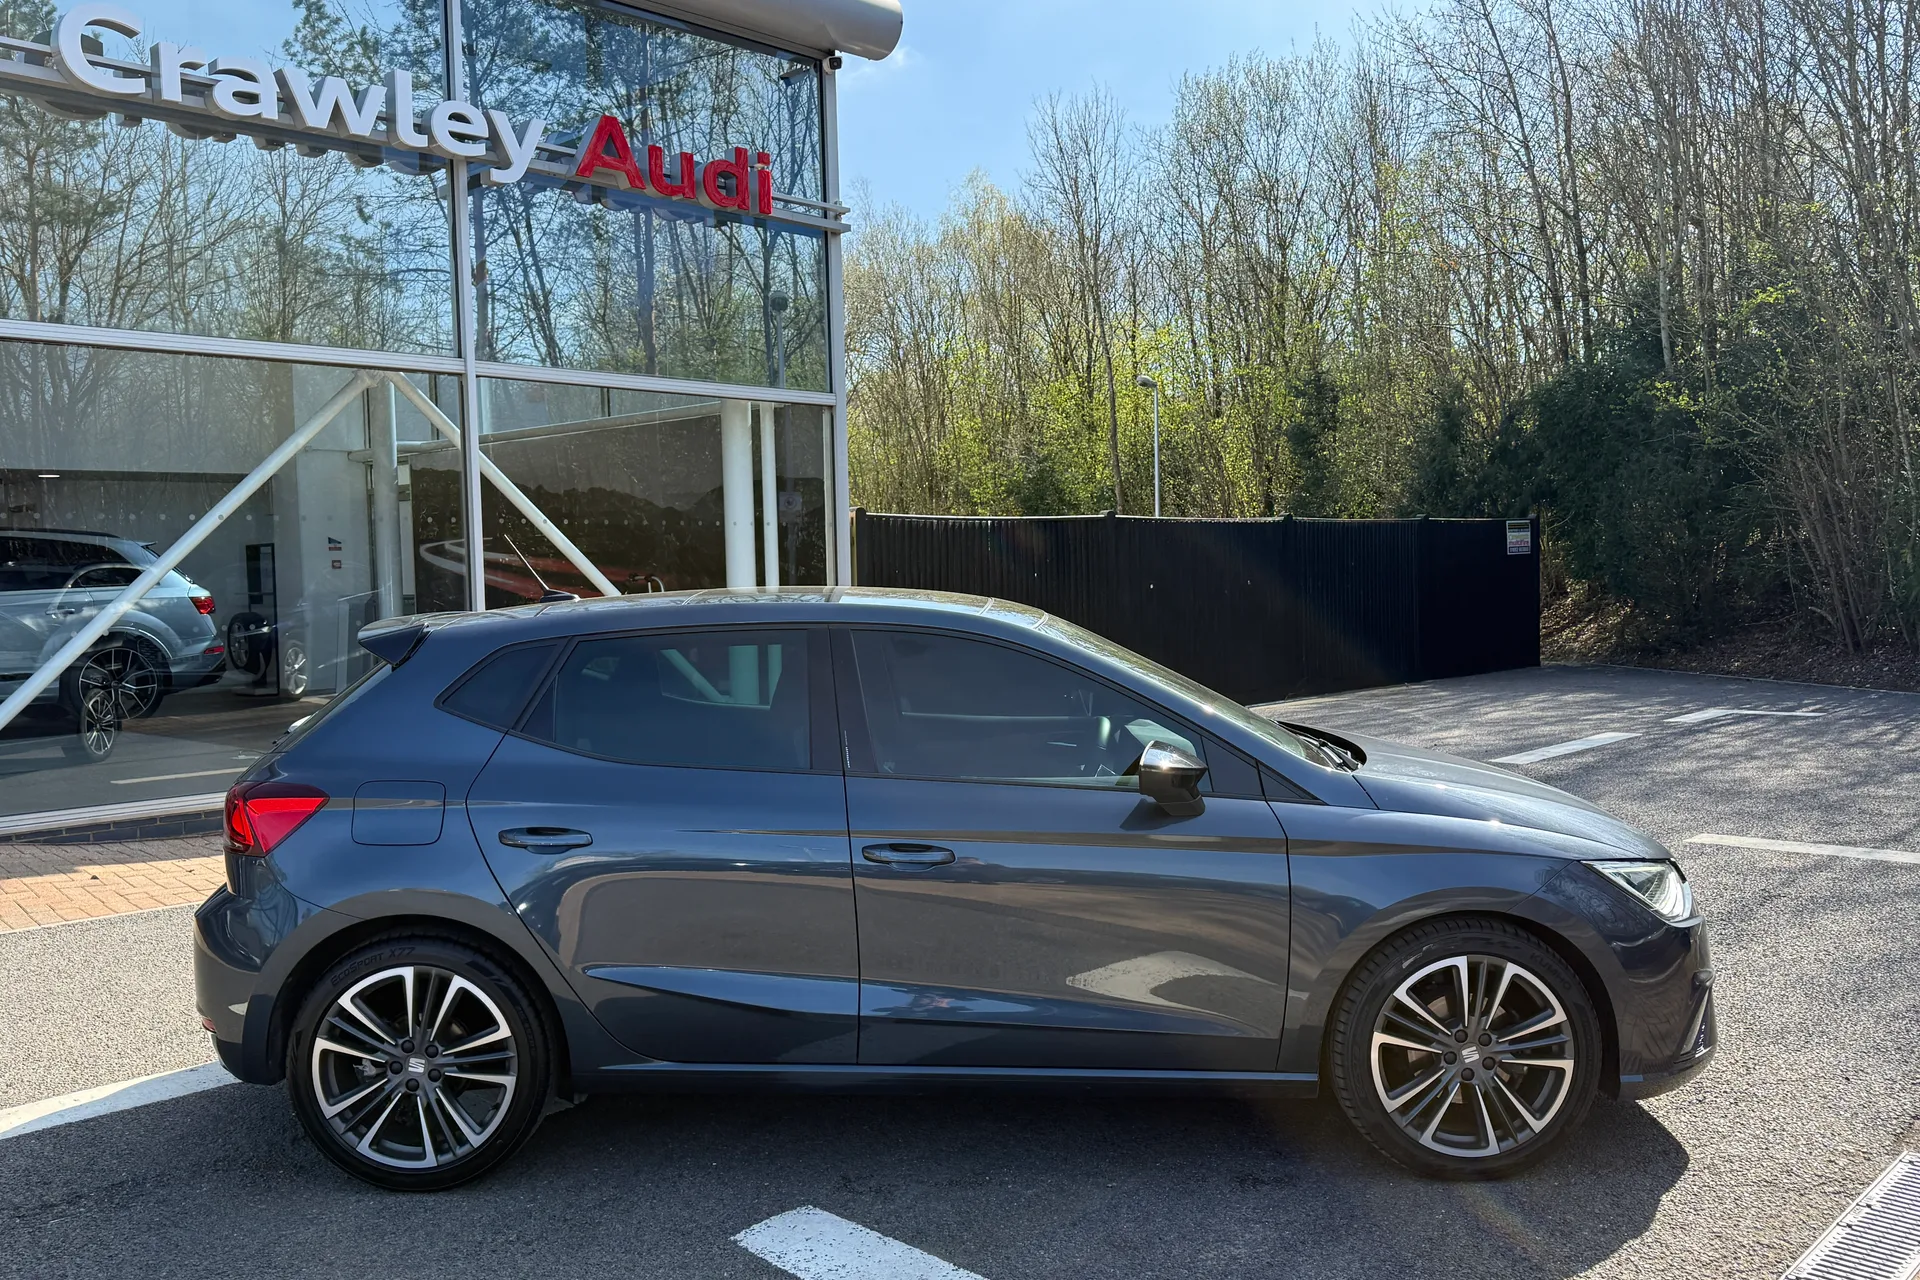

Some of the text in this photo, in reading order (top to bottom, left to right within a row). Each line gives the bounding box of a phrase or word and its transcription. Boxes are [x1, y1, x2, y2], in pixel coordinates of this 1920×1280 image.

[51, 4, 773, 215] Crawley Audi
[388, 946, 416, 959] X77
[1529, 952, 1572, 991] KUMHO
